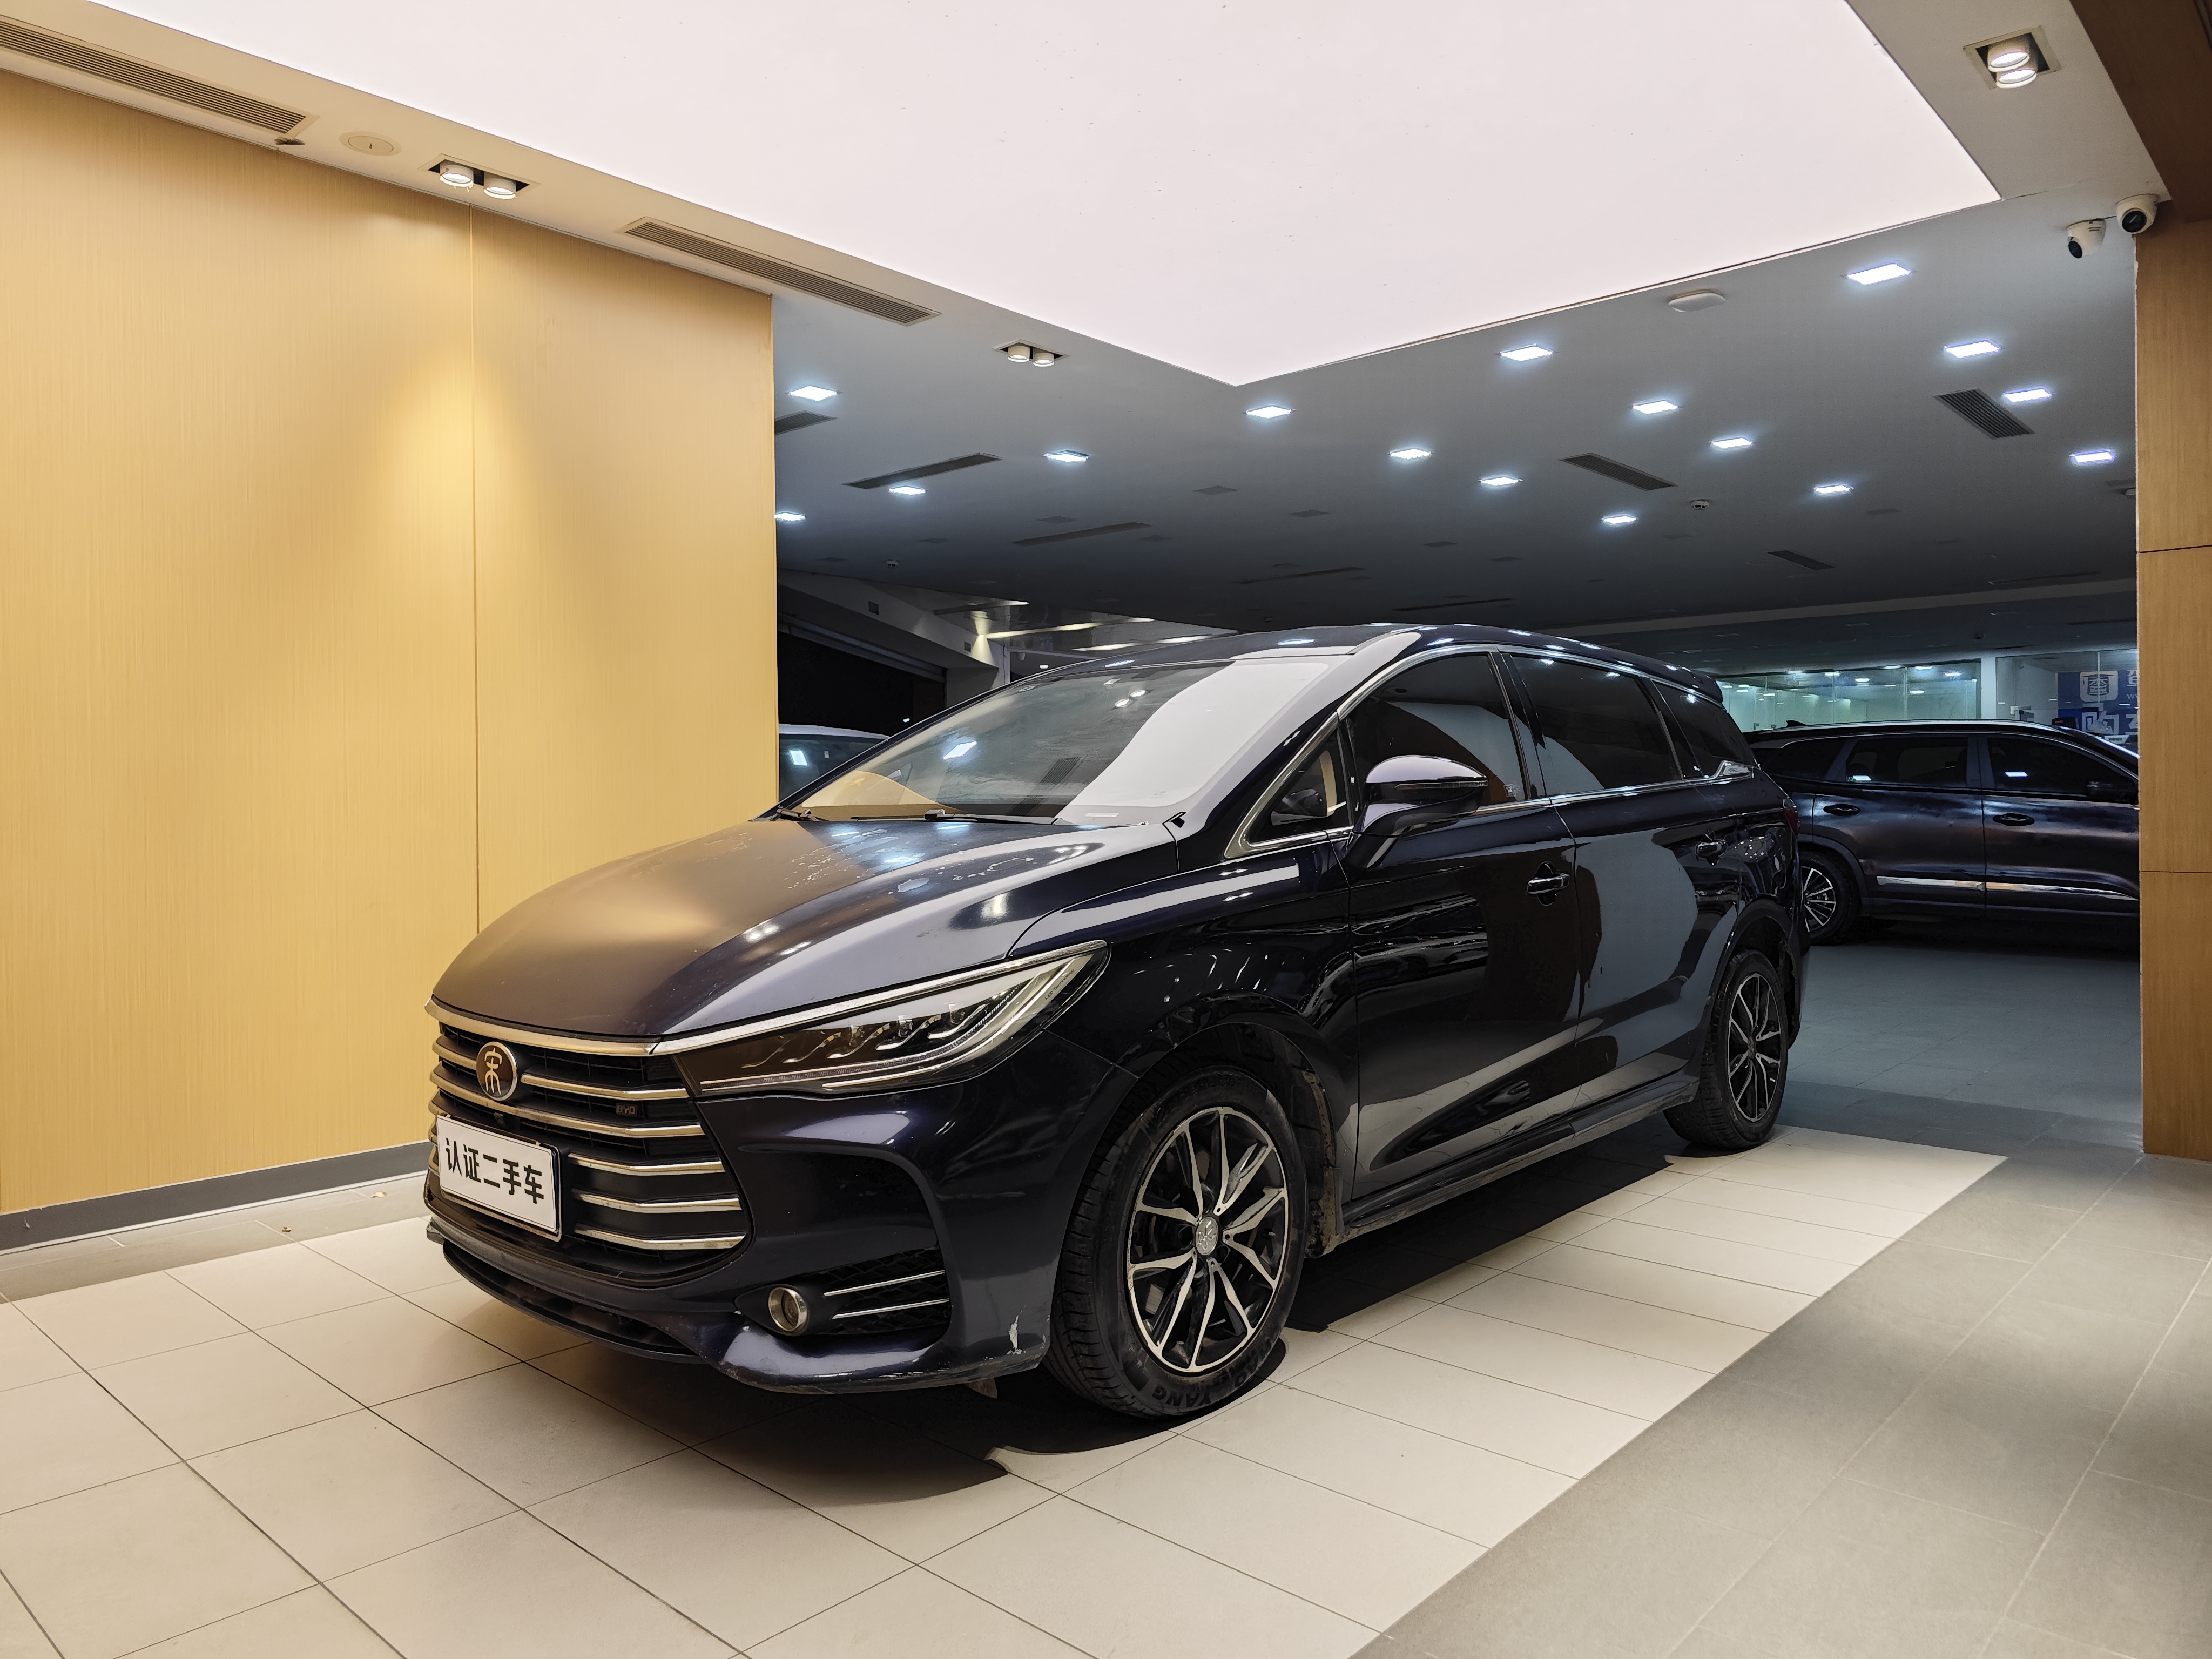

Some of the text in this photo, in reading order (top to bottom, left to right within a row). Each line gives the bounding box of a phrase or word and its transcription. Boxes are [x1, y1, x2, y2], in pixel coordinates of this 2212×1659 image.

[1044, 990, 1054, 1000] LED
[617, 1104, 635, 1115] BYD
[446, 1137, 544, 1204] 认证二手车
[1151, 1384, 1211, 1407] YANG
